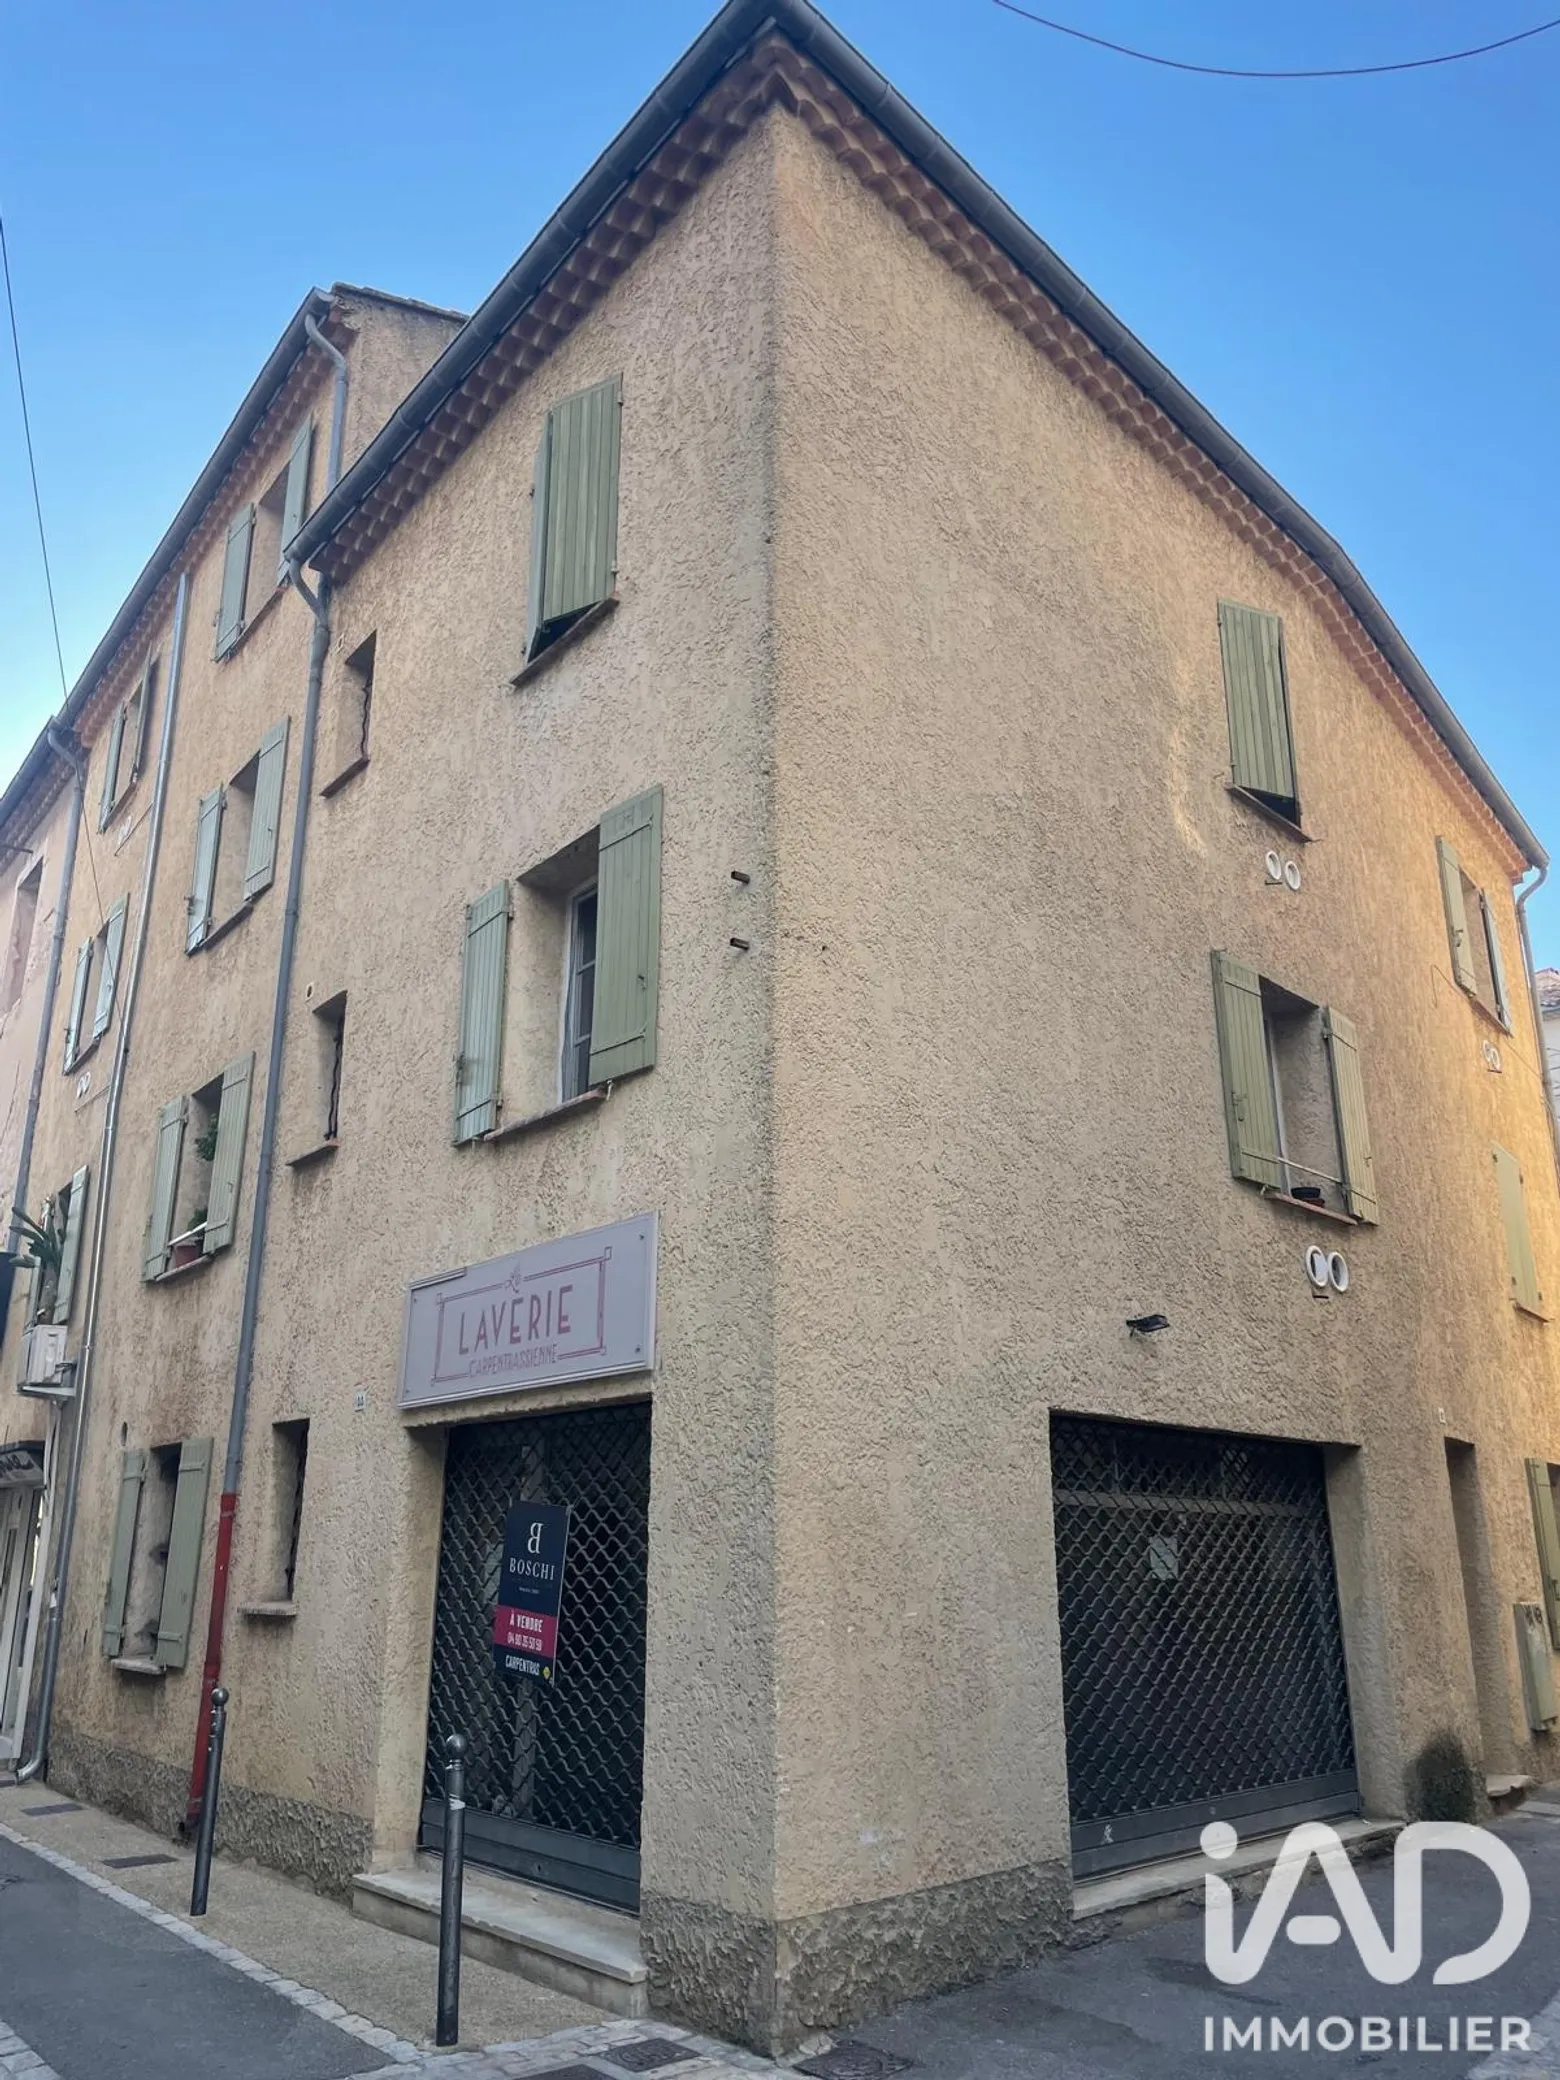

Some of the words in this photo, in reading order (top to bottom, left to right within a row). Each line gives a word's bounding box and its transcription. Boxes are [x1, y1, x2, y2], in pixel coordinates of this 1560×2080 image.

[459, 1285, 573, 1355] LAVERIE
[509, 1557, 554, 1581] BOSCHI
[517, 1614, 543, 1633] VENDRE
